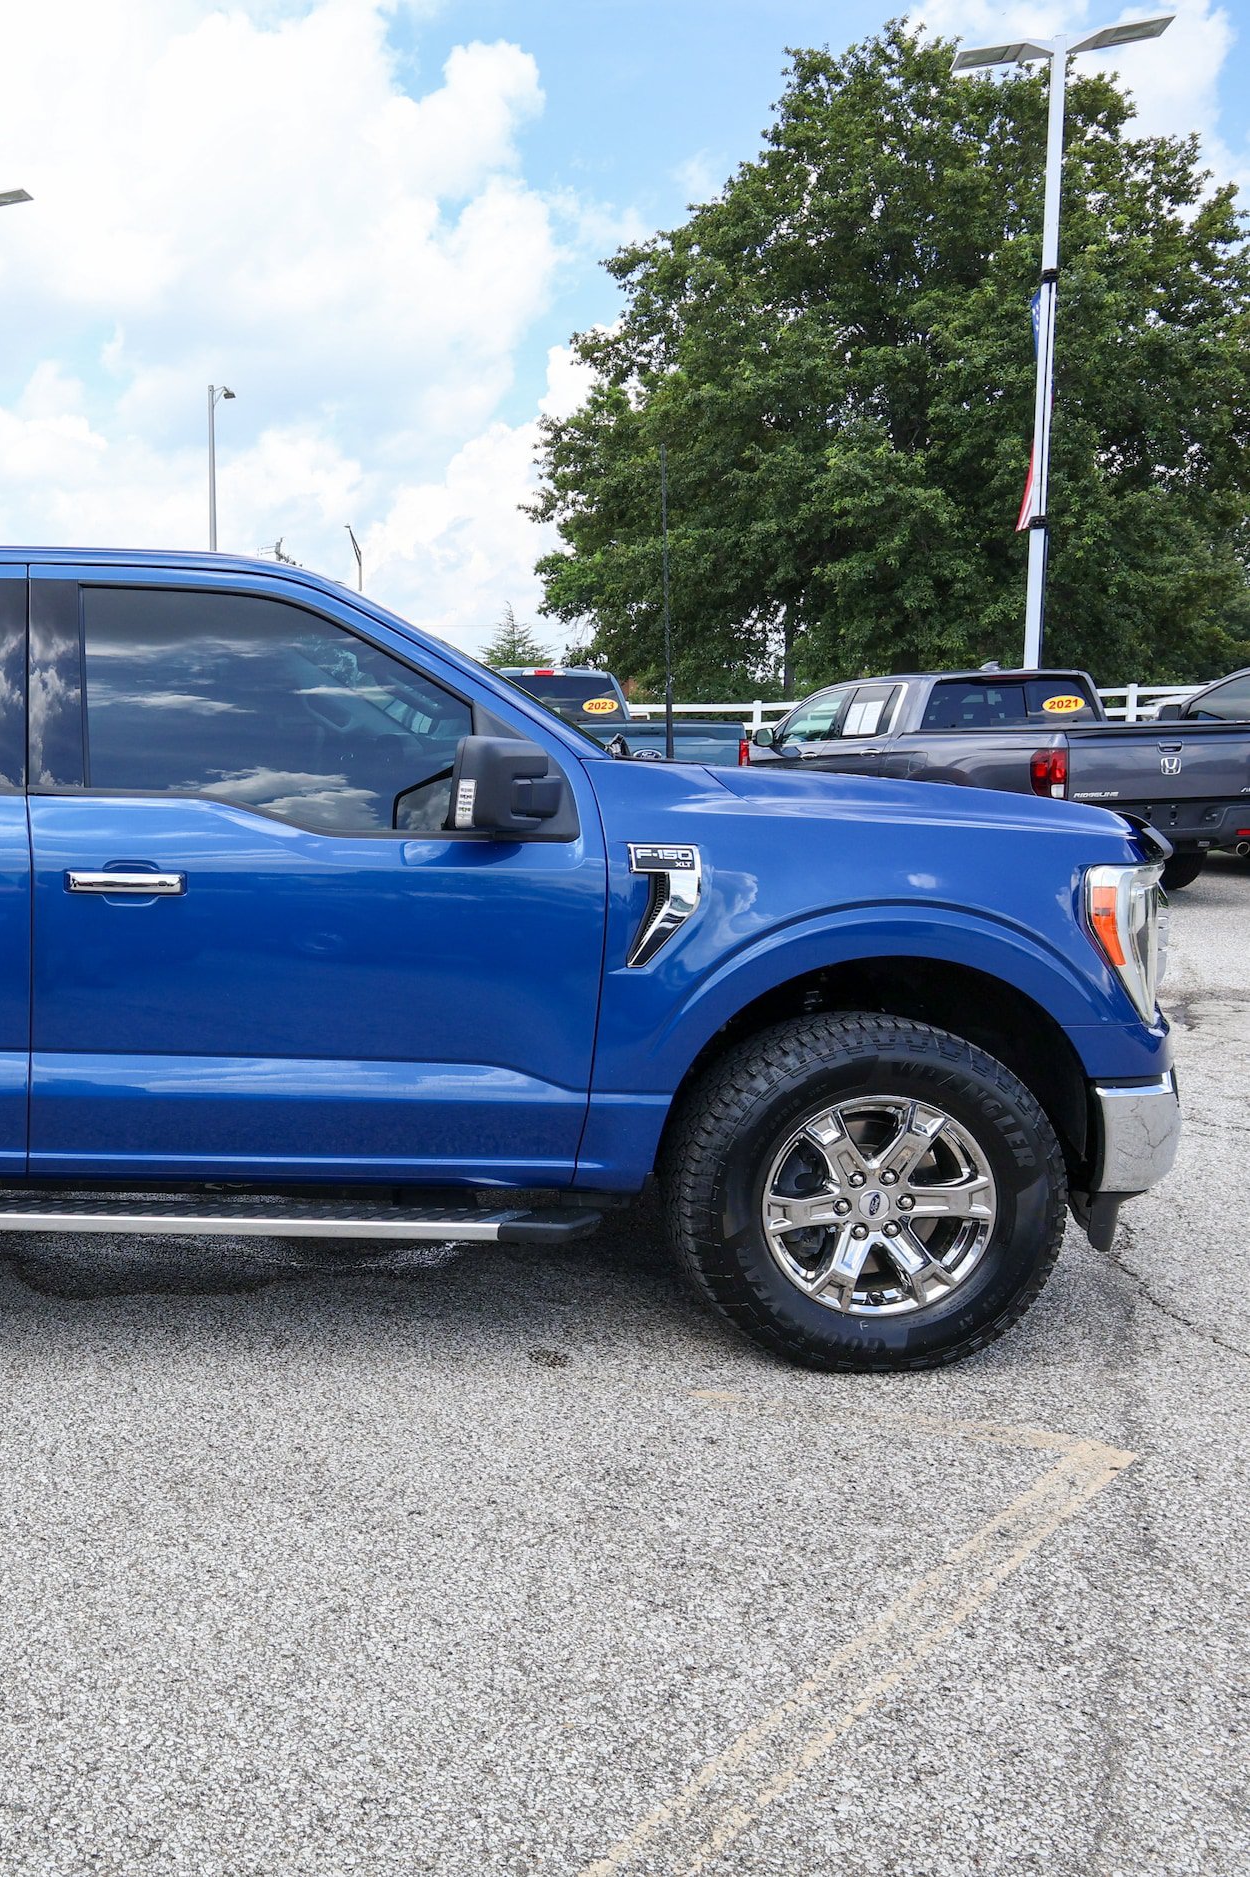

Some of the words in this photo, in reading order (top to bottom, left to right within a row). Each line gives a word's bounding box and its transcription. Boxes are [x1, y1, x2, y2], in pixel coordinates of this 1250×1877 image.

[587, 701, 615, 711] 2023
[1048, 698, 1078, 710] 2021
[635, 848, 693, 860] F-150
[892, 1062, 1037, 1168] WRANGLER
